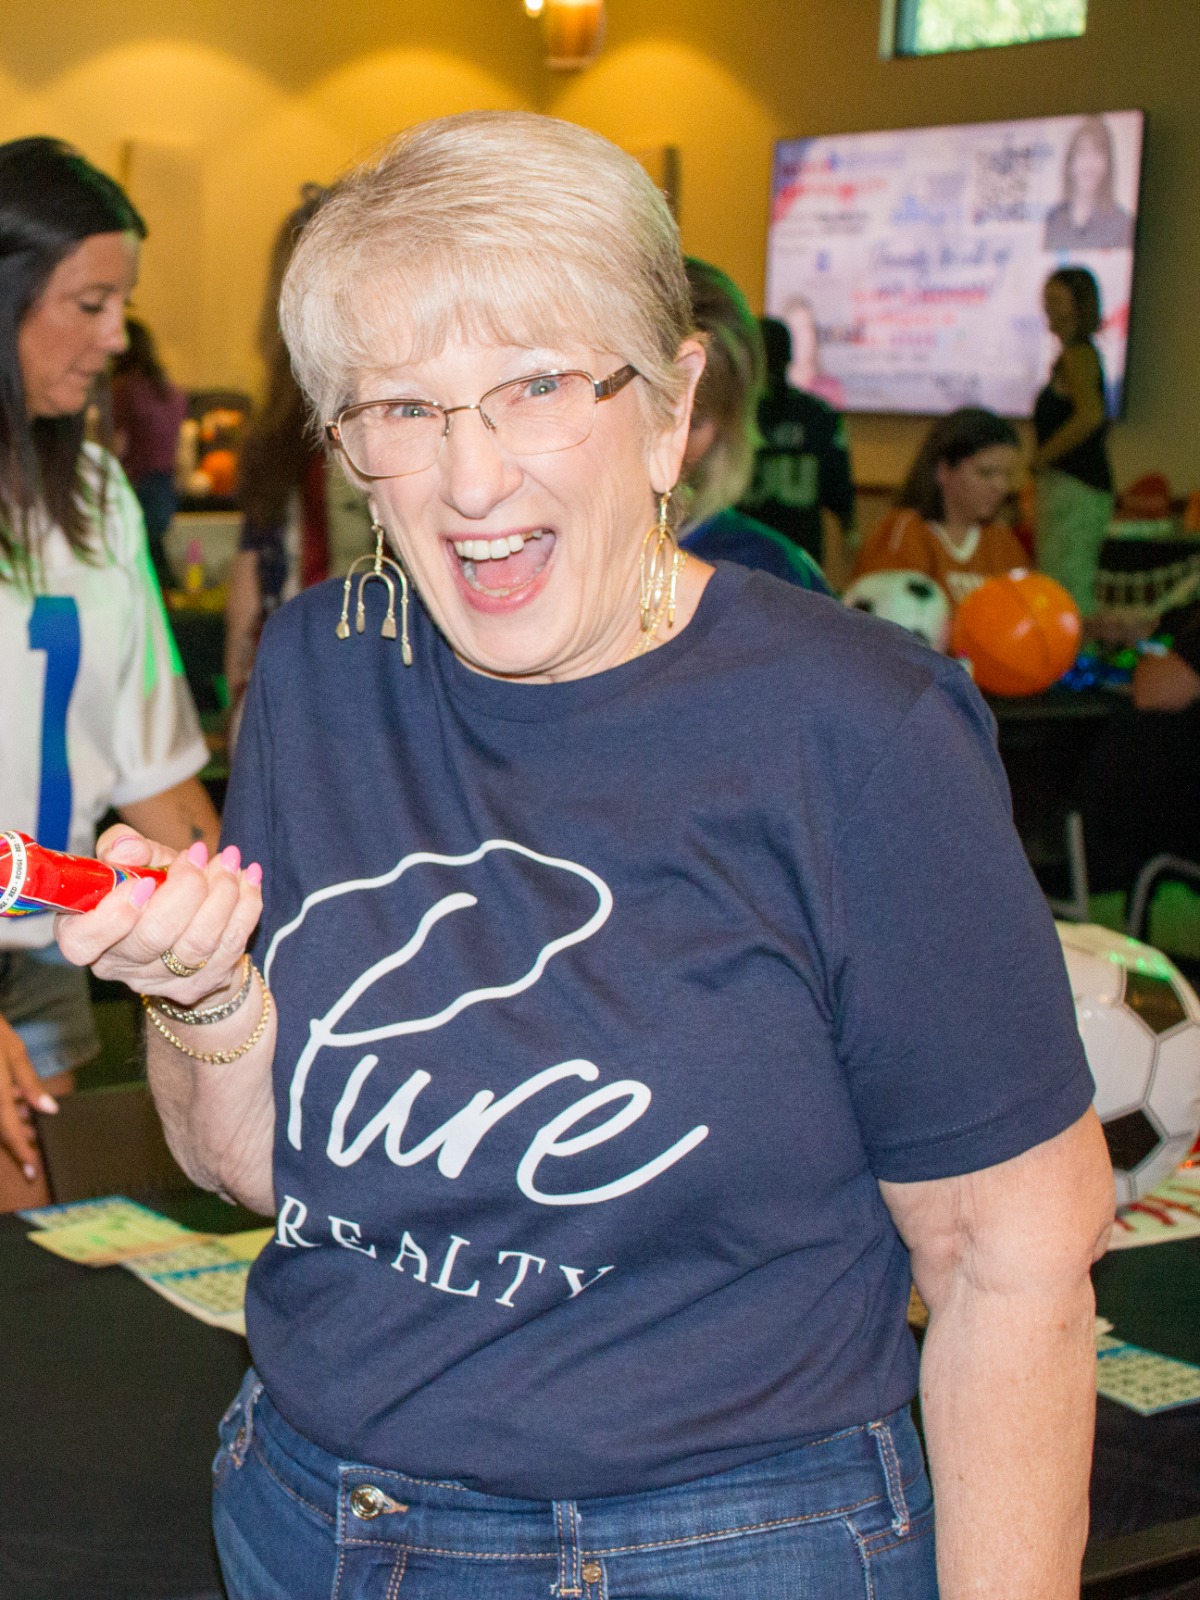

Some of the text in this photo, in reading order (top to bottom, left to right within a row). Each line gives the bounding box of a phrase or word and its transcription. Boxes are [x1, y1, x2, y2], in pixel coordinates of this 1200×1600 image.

[14, 859, 23, 881] ROUGE
[264, 839, 710, 1205] Pure
[274, 1194, 616, 1307] REALTY
